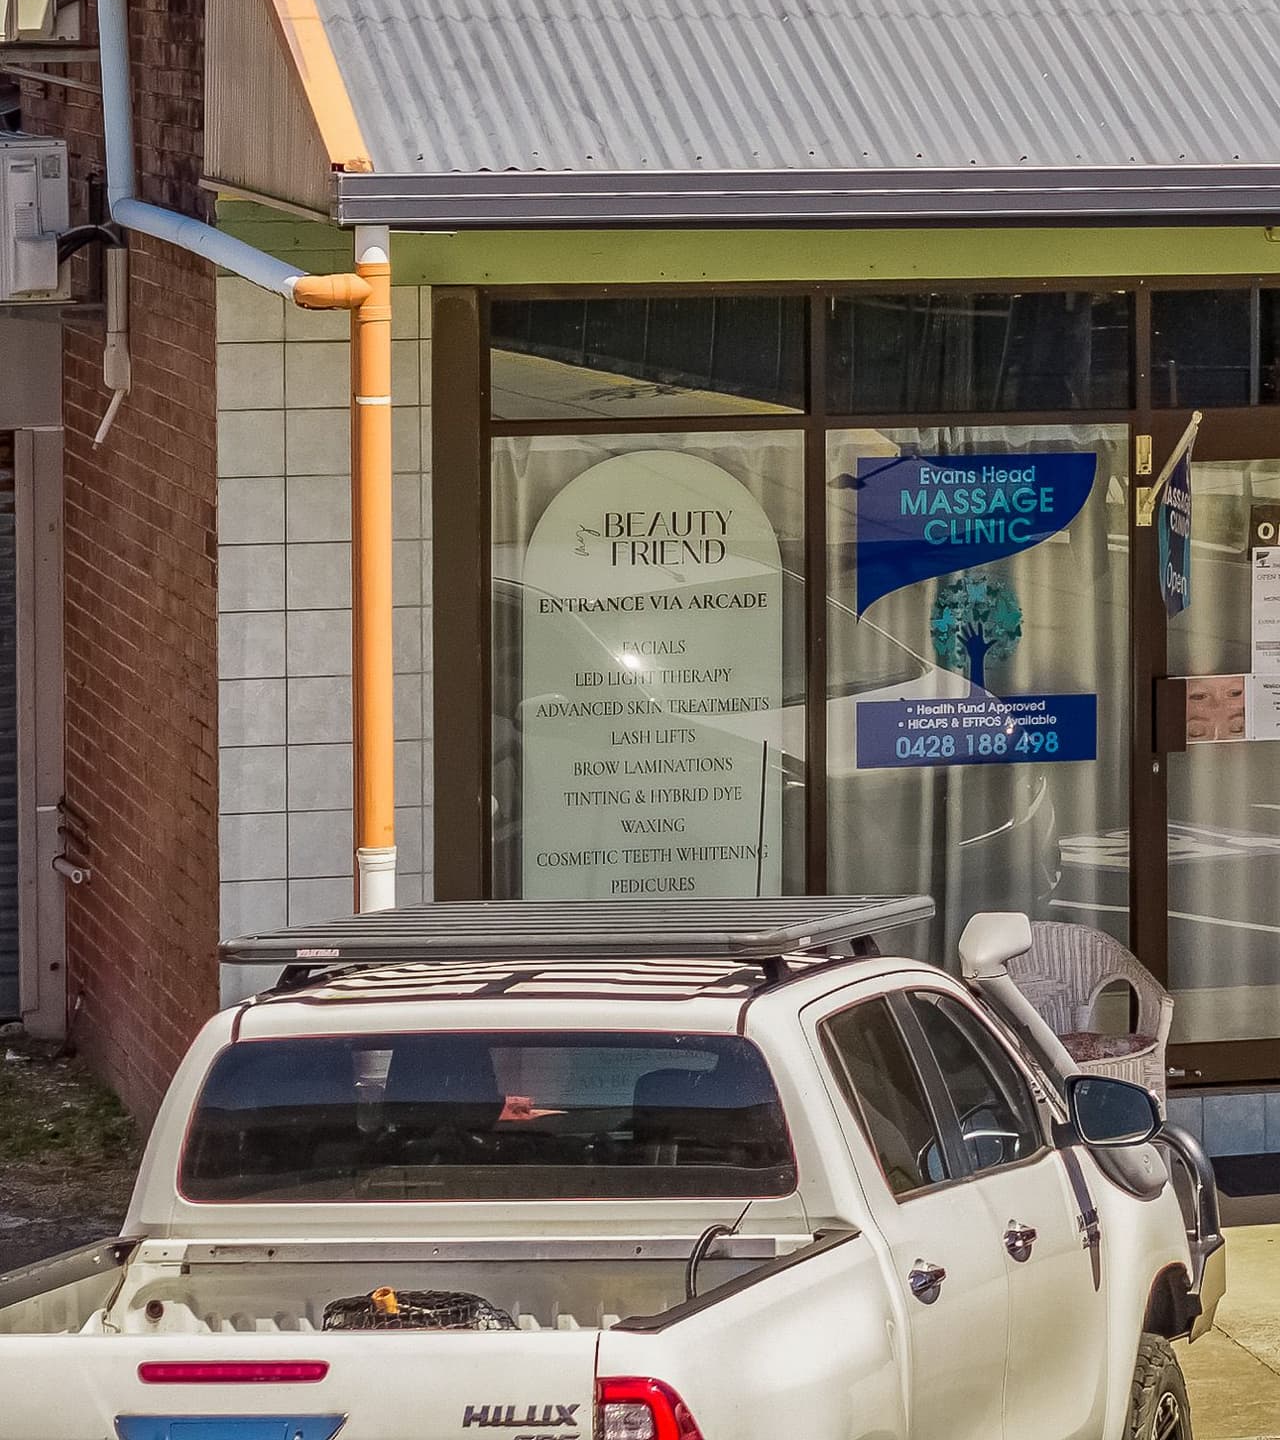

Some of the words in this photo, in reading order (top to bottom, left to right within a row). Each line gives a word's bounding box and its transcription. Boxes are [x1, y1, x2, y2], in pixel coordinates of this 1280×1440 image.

[920, 466, 976, 486] Evans
[982, 465, 1036, 484] Head
[901, 486, 1054, 516] MASSAGE
[604, 510, 734, 538] BEAUTY
[924, 516, 1032, 546] CLINIC
[611, 539, 726, 567] FRIEND
[1167, 562, 1187, 595] Open
[539, 595, 645, 615] ENTRANCE
[651, 594, 685, 611] VIA
[687, 592, 768, 610] ARCADE
[622, 639, 686, 656] FACIALS
[575, 671, 603, 688] LED
[607, 670, 655, 687] LIGHT
[660, 668, 732, 685] THERAPY
[536, 700, 624, 719] ADVANCED
[627, 699, 663, 715] SKIN
[669, 696, 770, 714] TREATMENTS
[917, 703, 955, 715] Health
[957, 702, 985, 714] Fund
[988, 700, 1045, 714] Approved
[908, 718, 948, 729] HICAPS
[951, 718, 959, 728] &
[962, 716, 1001, 728] EFTPOS
[1004, 714, 1057, 726] Available
[611, 730, 650, 746] LASH
[655, 729, 696, 745] LIFTS
[896, 735, 955, 759] 0428
[966, 733, 1007, 755] 188
[1015, 732, 1059, 754] 498
[573, 760, 620, 777] BROW
[624, 757, 733, 775] LAMINATIONS
[564, 790, 631, 807] TINTING
[635, 788, 646, 804] &
[650, 787, 709, 804] HYBRID
[713, 785, 742, 802] DYE
[621, 818, 685, 834] WAXING
[537, 851, 619, 868] COSMETIC
[622, 848, 672, 864] TEETH
[676, 845, 769, 863] WHITENING
[611, 877, 696, 894] PEDICURES
[463, 1404, 580, 1427] HILUX
